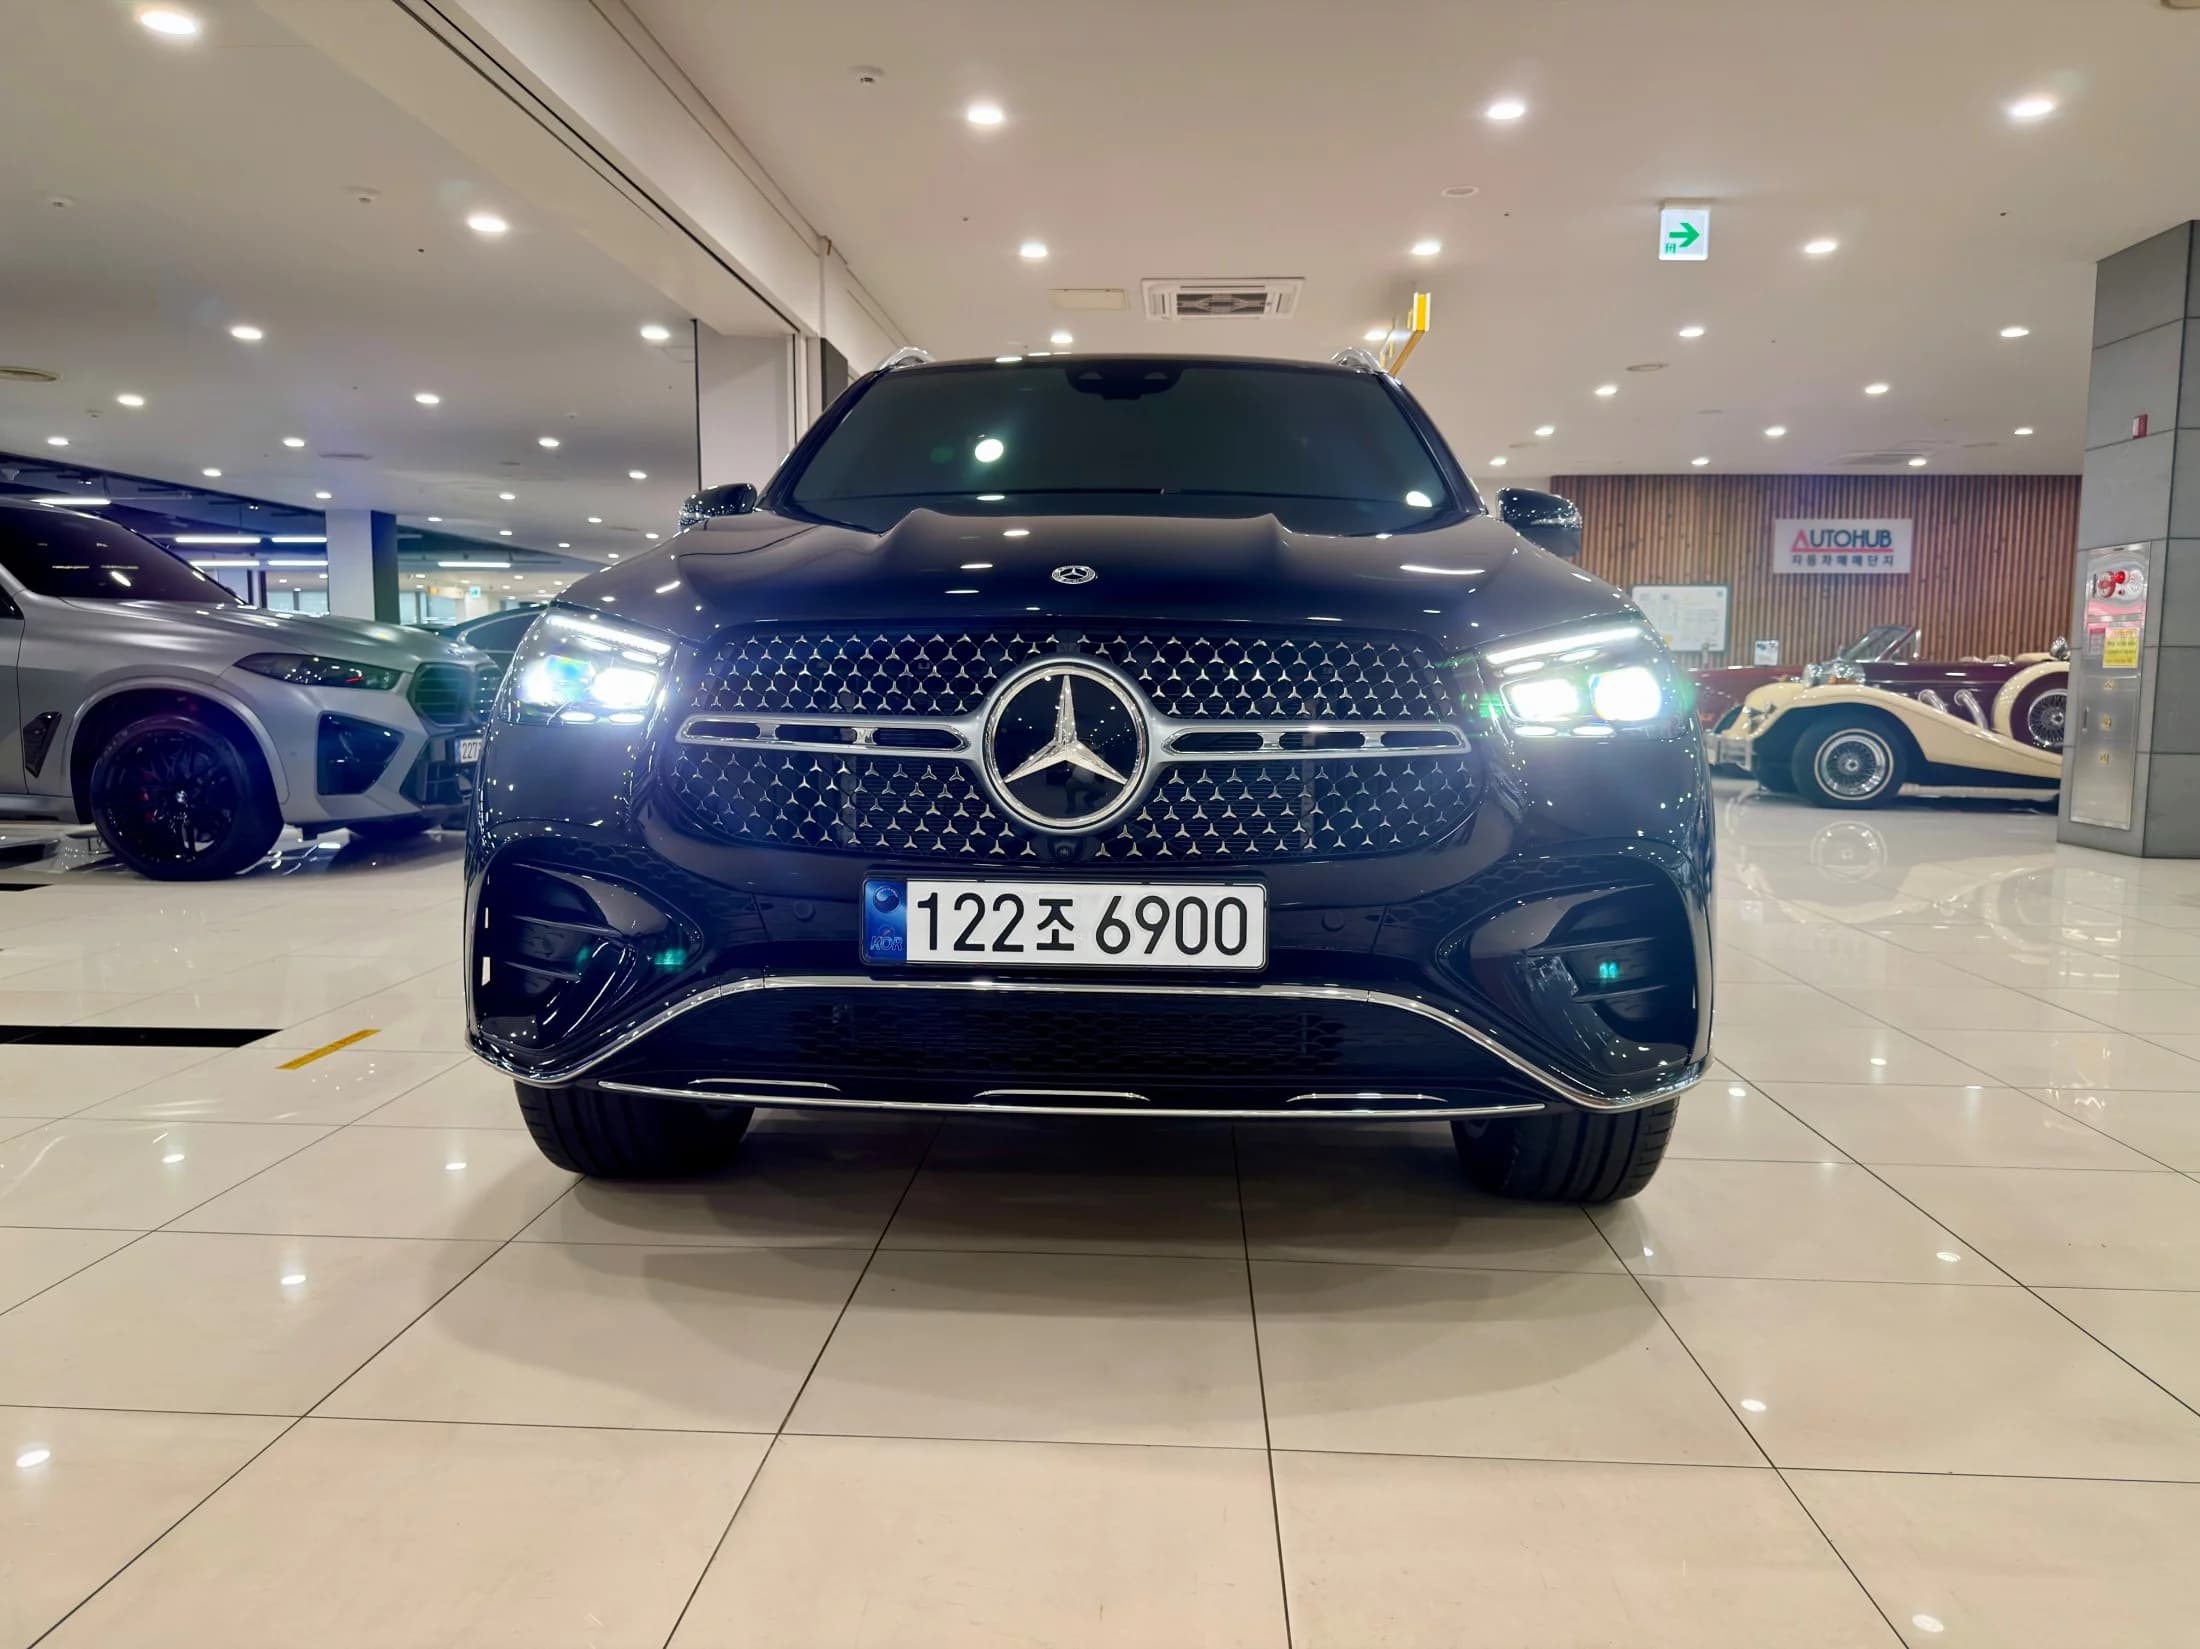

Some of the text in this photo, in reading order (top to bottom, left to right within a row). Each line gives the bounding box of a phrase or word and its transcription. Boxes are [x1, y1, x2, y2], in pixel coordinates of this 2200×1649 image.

[1792, 528, 1893, 549] AUTOHUB
[462, 742, 481, 760] 227
[917, 892, 1248, 956] 122조 6900
[870, 936, 904, 951] KOR
